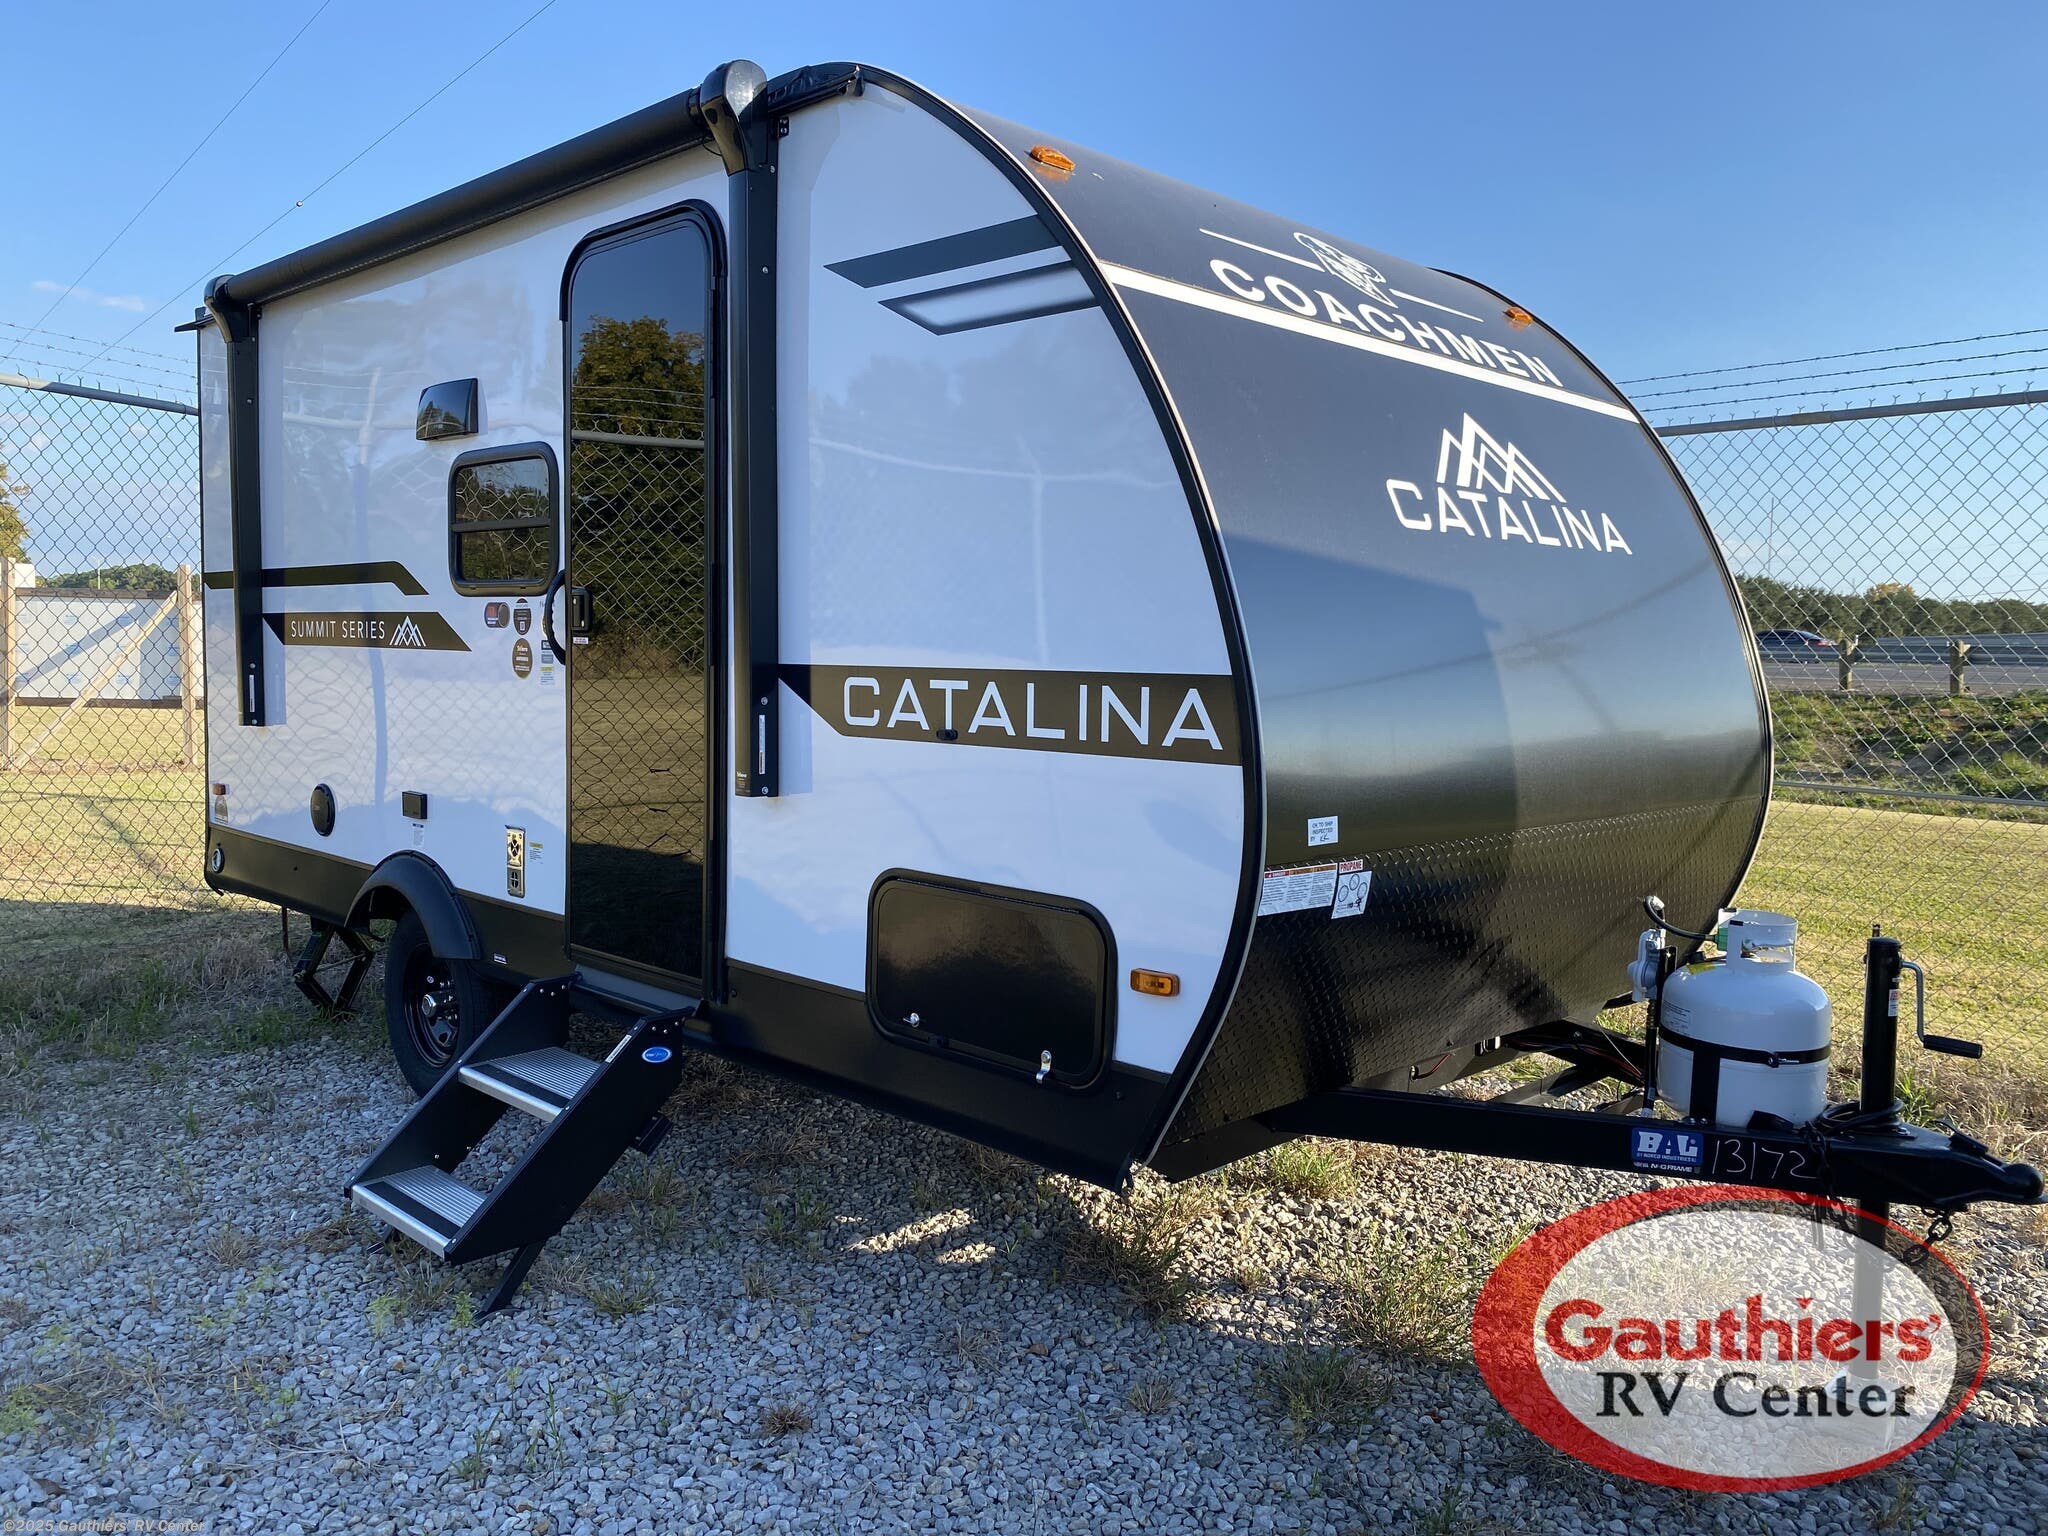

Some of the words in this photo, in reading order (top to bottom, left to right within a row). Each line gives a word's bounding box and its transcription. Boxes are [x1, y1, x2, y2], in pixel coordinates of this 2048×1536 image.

[1209, 258, 1564, 387] COACHMEN
[1385, 478, 1632, 555] CATALINA
[291, 620, 336, 638] SUMMIT
[342, 621, 385, 639] SERIES
[843, 676, 1223, 751] CATALINA
[1340, 862, 1362, 872] PROPANE
[1637, 1131, 1698, 1157] BAL
[1711, 1138, 1818, 1181] 13172
